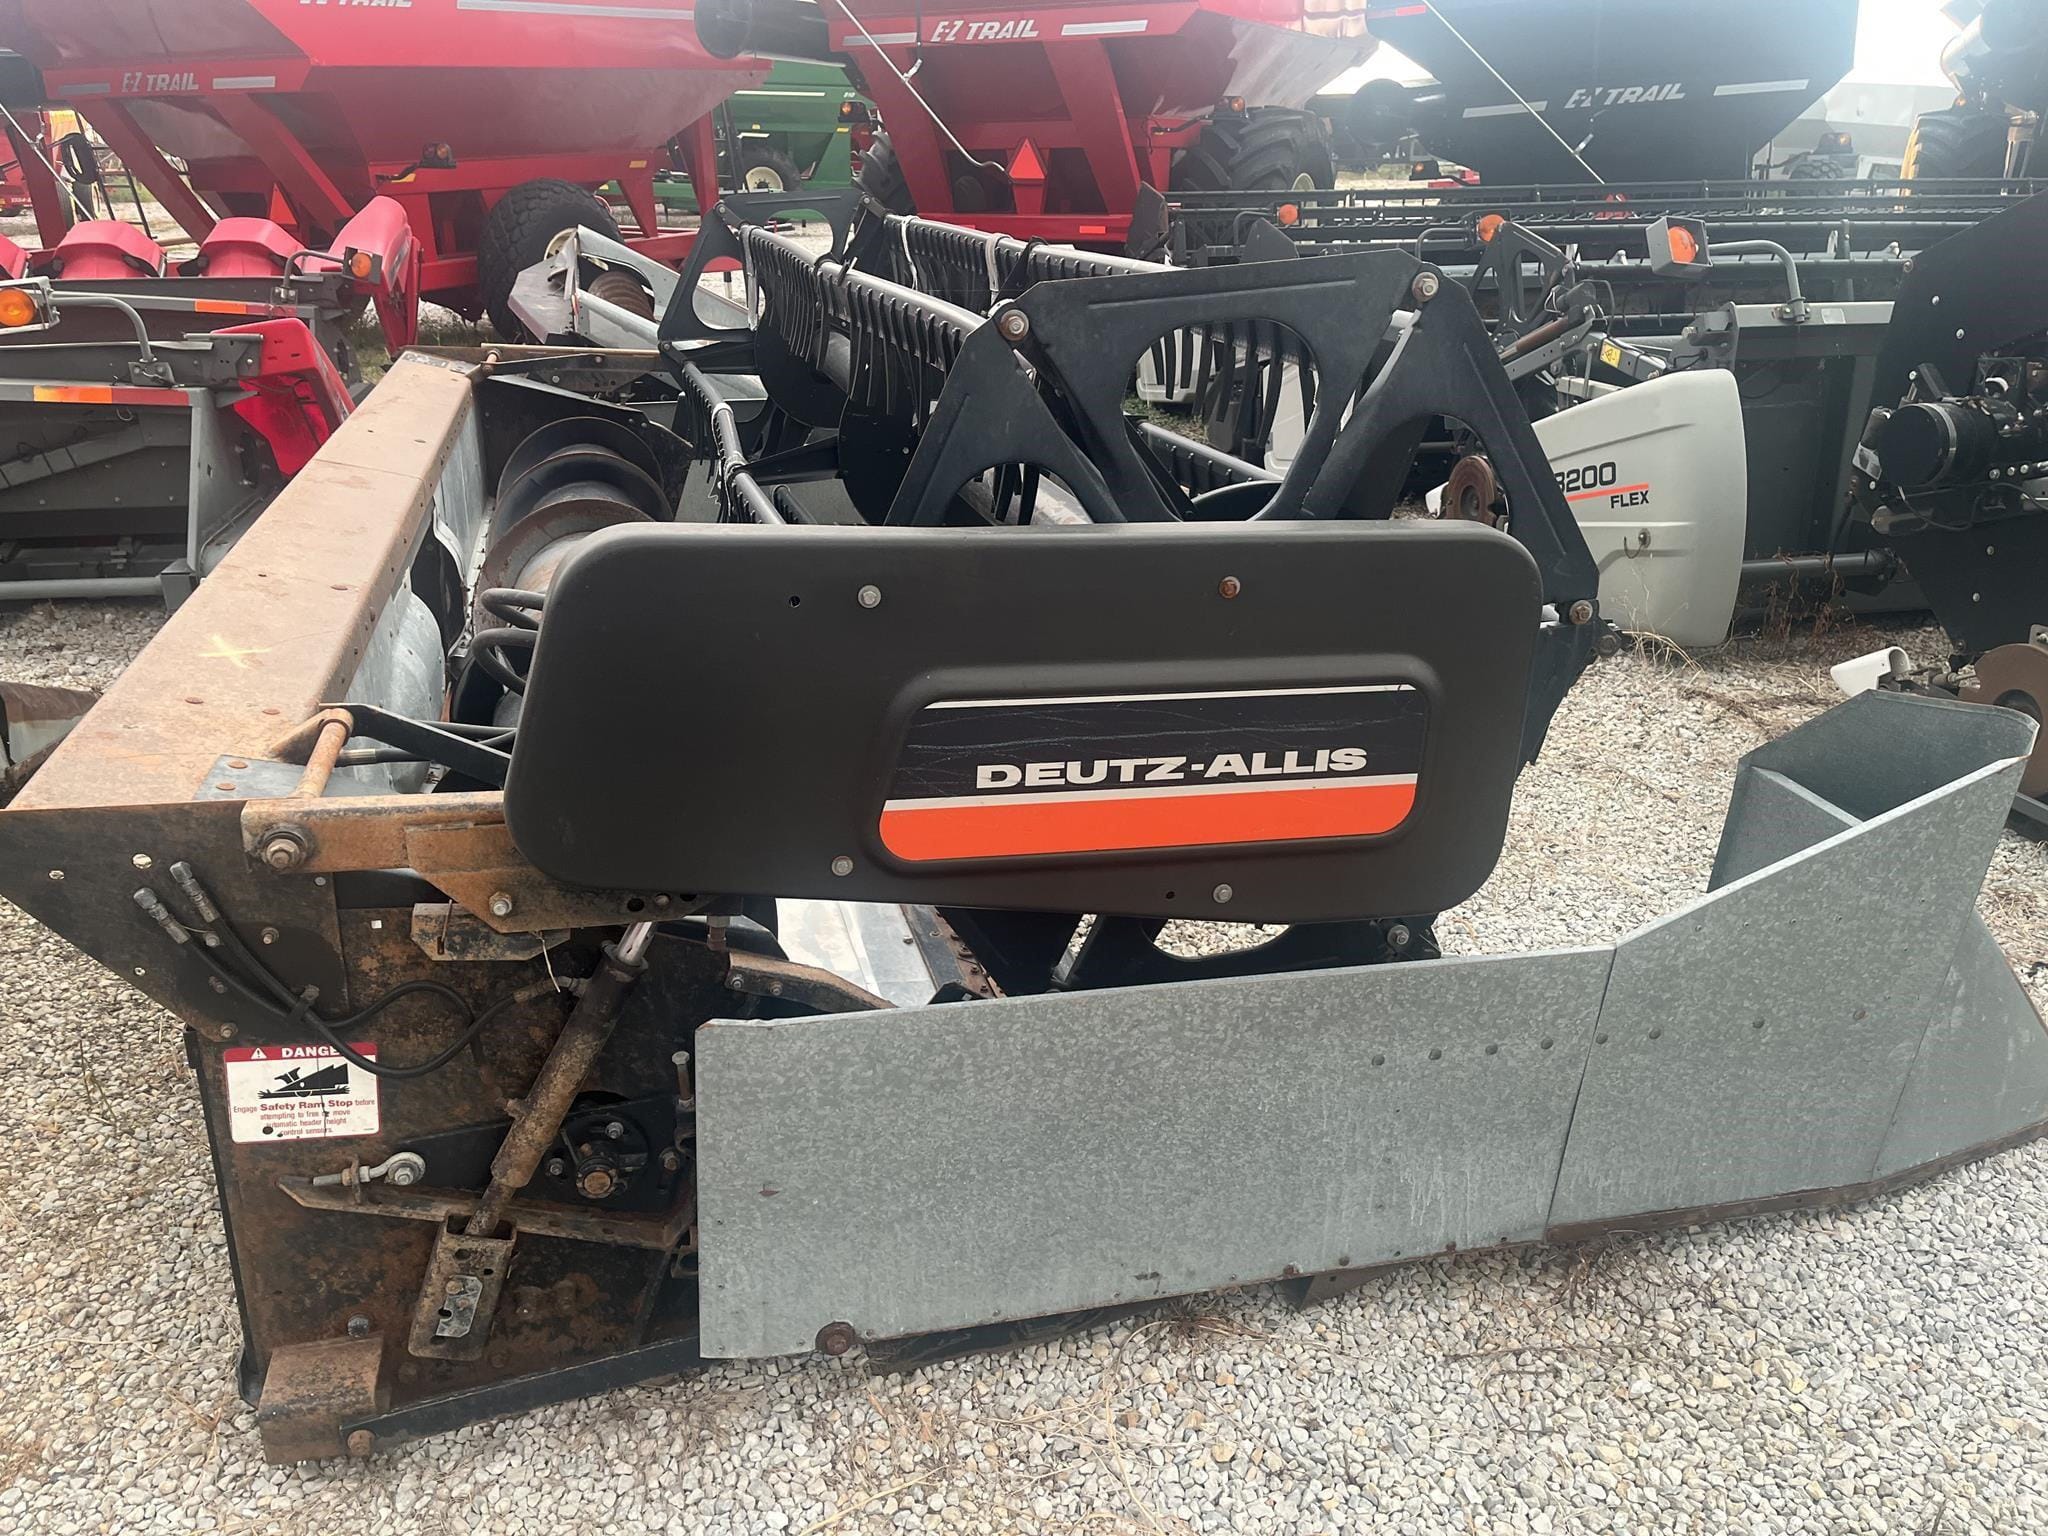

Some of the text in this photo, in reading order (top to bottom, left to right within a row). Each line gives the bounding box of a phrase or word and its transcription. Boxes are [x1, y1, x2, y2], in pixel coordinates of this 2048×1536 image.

[930, 19, 1040, 42] E-Z TRAIL
[146, 72, 199, 92] TRAIL
[1603, 82, 1687, 106] TRAIL
[1610, 490, 1650, 509] FLEX
[976, 747, 1368, 789] DEUTZ-ALLIS
[281, 1045, 340, 1058] DANGE
[260, 1103, 295, 1111] Safety
[299, 1101, 324, 1109] Ram
[328, 1100, 353, 1108] Stop
